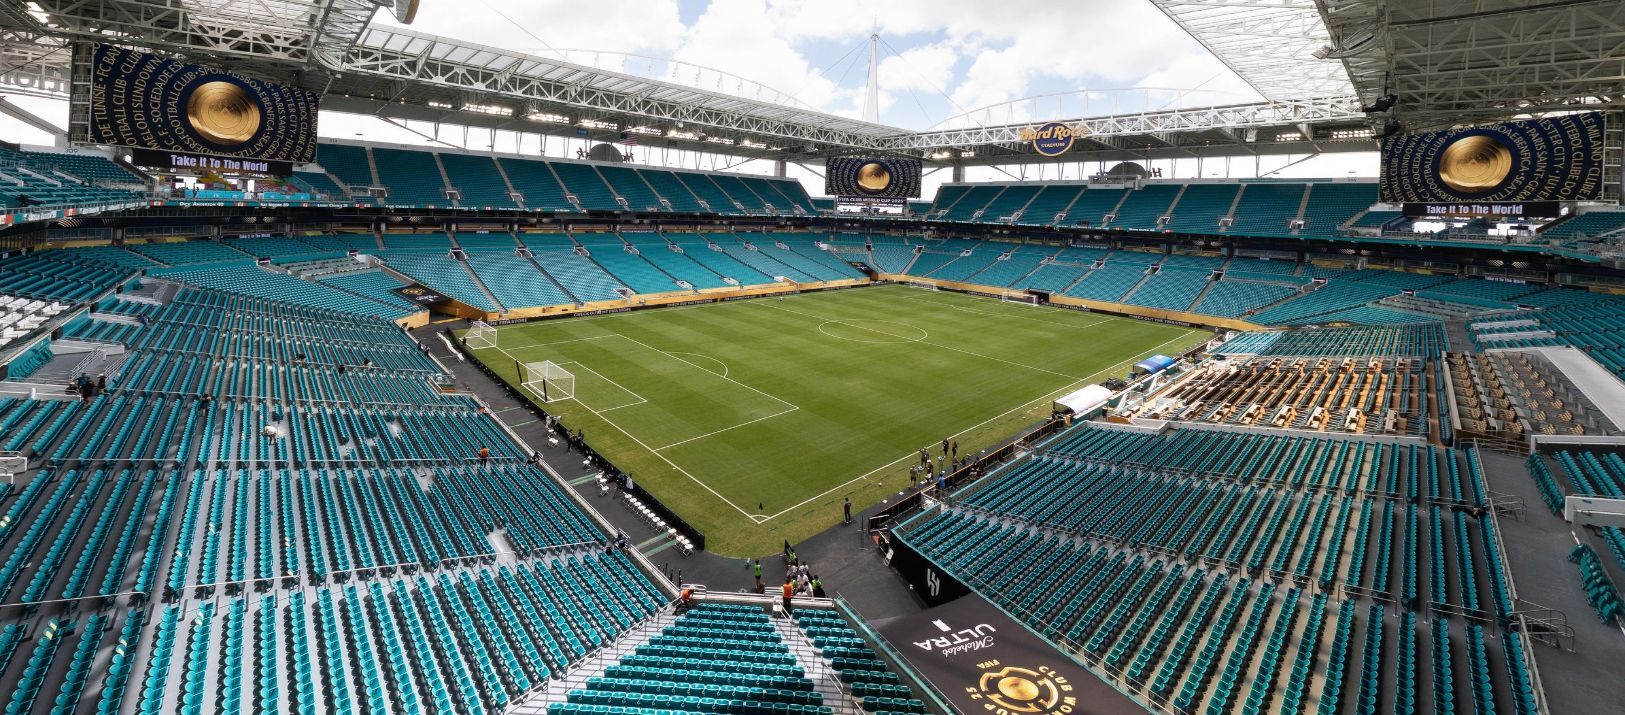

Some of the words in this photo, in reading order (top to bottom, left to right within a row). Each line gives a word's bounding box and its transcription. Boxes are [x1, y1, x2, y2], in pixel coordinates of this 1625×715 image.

[102, 45, 121, 65] BAY
[97, 63, 112, 78] FC
[132, 56, 164, 108] SUNDOWN
[174, 71, 197, 91] CLUB
[113, 79, 127, 105] CLUB
[98, 123, 114, 138] DE
[171, 154, 197, 167] Take
[200, 156, 209, 168] It
[210, 157, 221, 168] To
[224, 159, 240, 170] The
[243, 160, 268, 172] World
[1553, 146, 1565, 169] CITY
[1426, 205, 1447, 214] Take
[1449, 205, 1456, 214] It
[1459, 205, 1469, 214] To
[1472, 205, 1489, 214] The
[1492, 204, 1523, 215] World
[913, 623, 996, 650] ULTRA
[942, 635, 994, 658] Michelob
[976, 659, 1000, 669] FIFA
[1038, 665, 1073, 692] CLUB
[965, 687, 983, 700] 25
